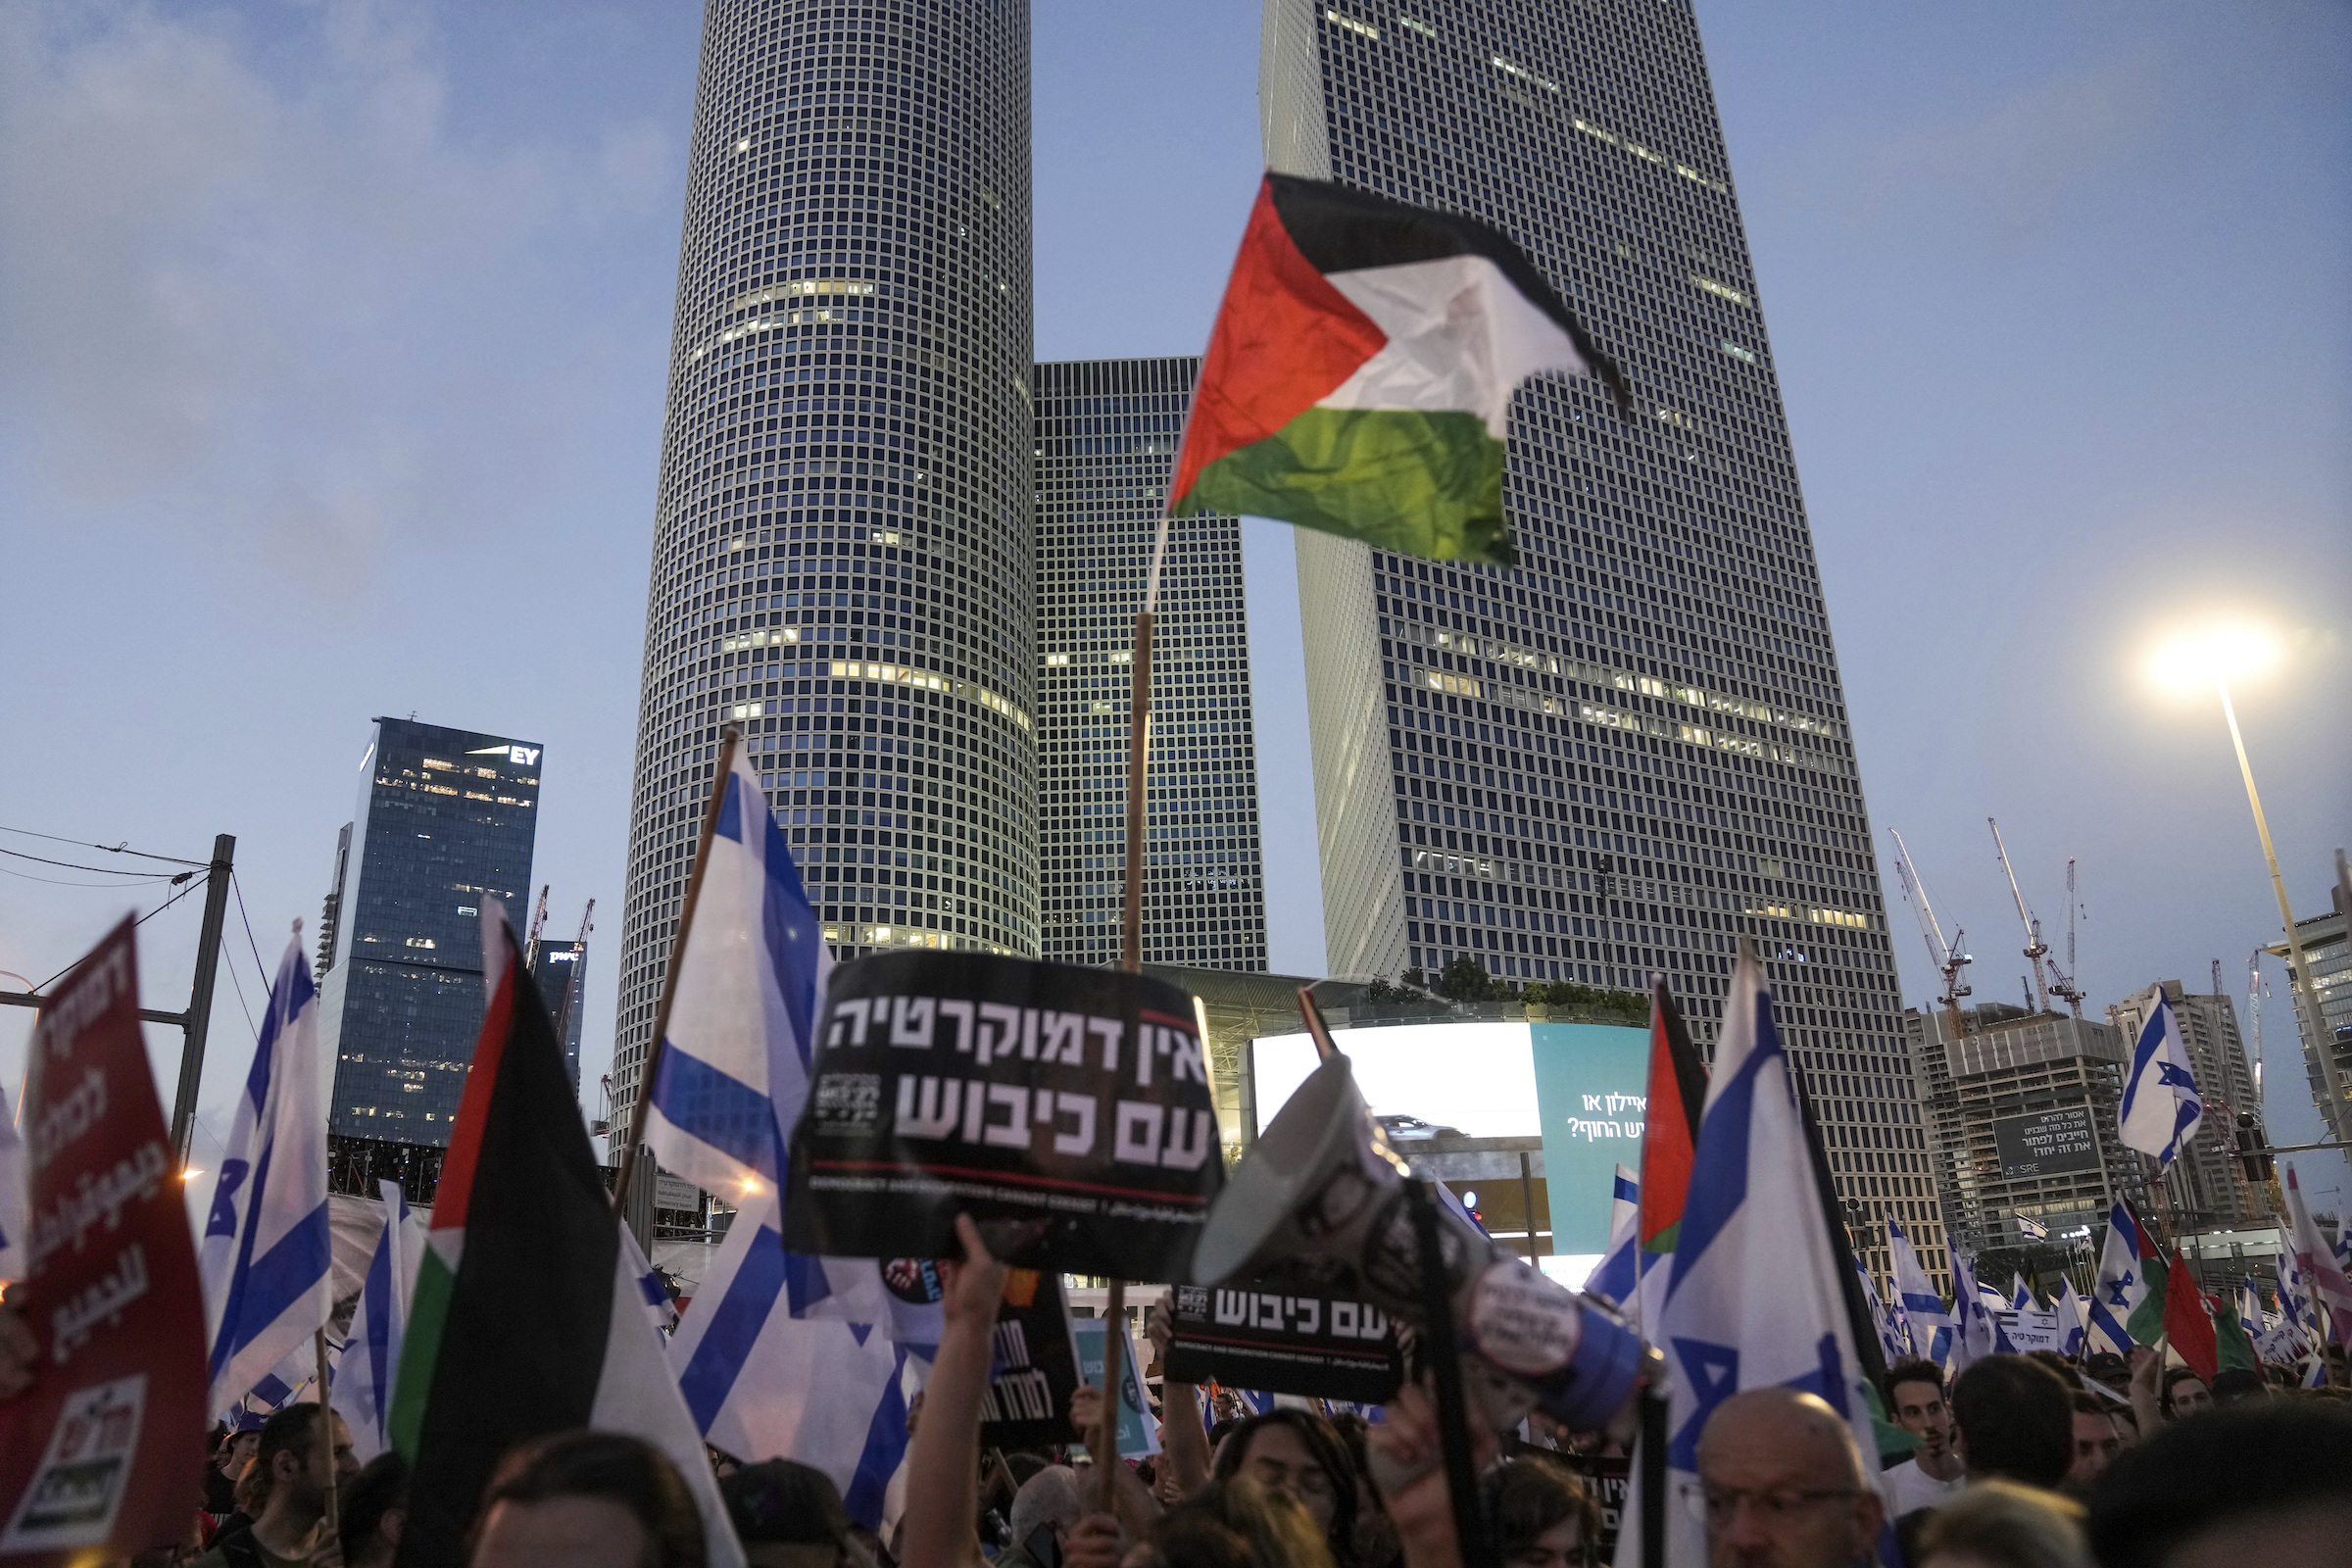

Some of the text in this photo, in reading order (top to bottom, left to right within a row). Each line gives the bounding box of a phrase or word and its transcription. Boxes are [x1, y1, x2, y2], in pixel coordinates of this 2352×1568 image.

[510, 745, 540, 765] EY
[549, 951, 579, 963] pwc
[826, 995, 1208, 1088] אין דמוקרטיה
[1582, 1091, 1647, 1116] איילון או
[894, 1073, 1211, 1172] עם כיבוש
[2040, 1110, 2084, 1123] אסור להרוס
[2061, 1121, 2073, 1130] כל
[2073, 1119, 2086, 1128] את
[1567, 1117, 1645, 1143] יש החוף?
[2022, 1129, 2089, 1147] חייבים לפתור
[2024, 1125, 2047, 1135] שבנינו
[2034, 1141, 2091, 1156] את זה יחד!
[1214, 1289, 1389, 1341] עם כיבוש
